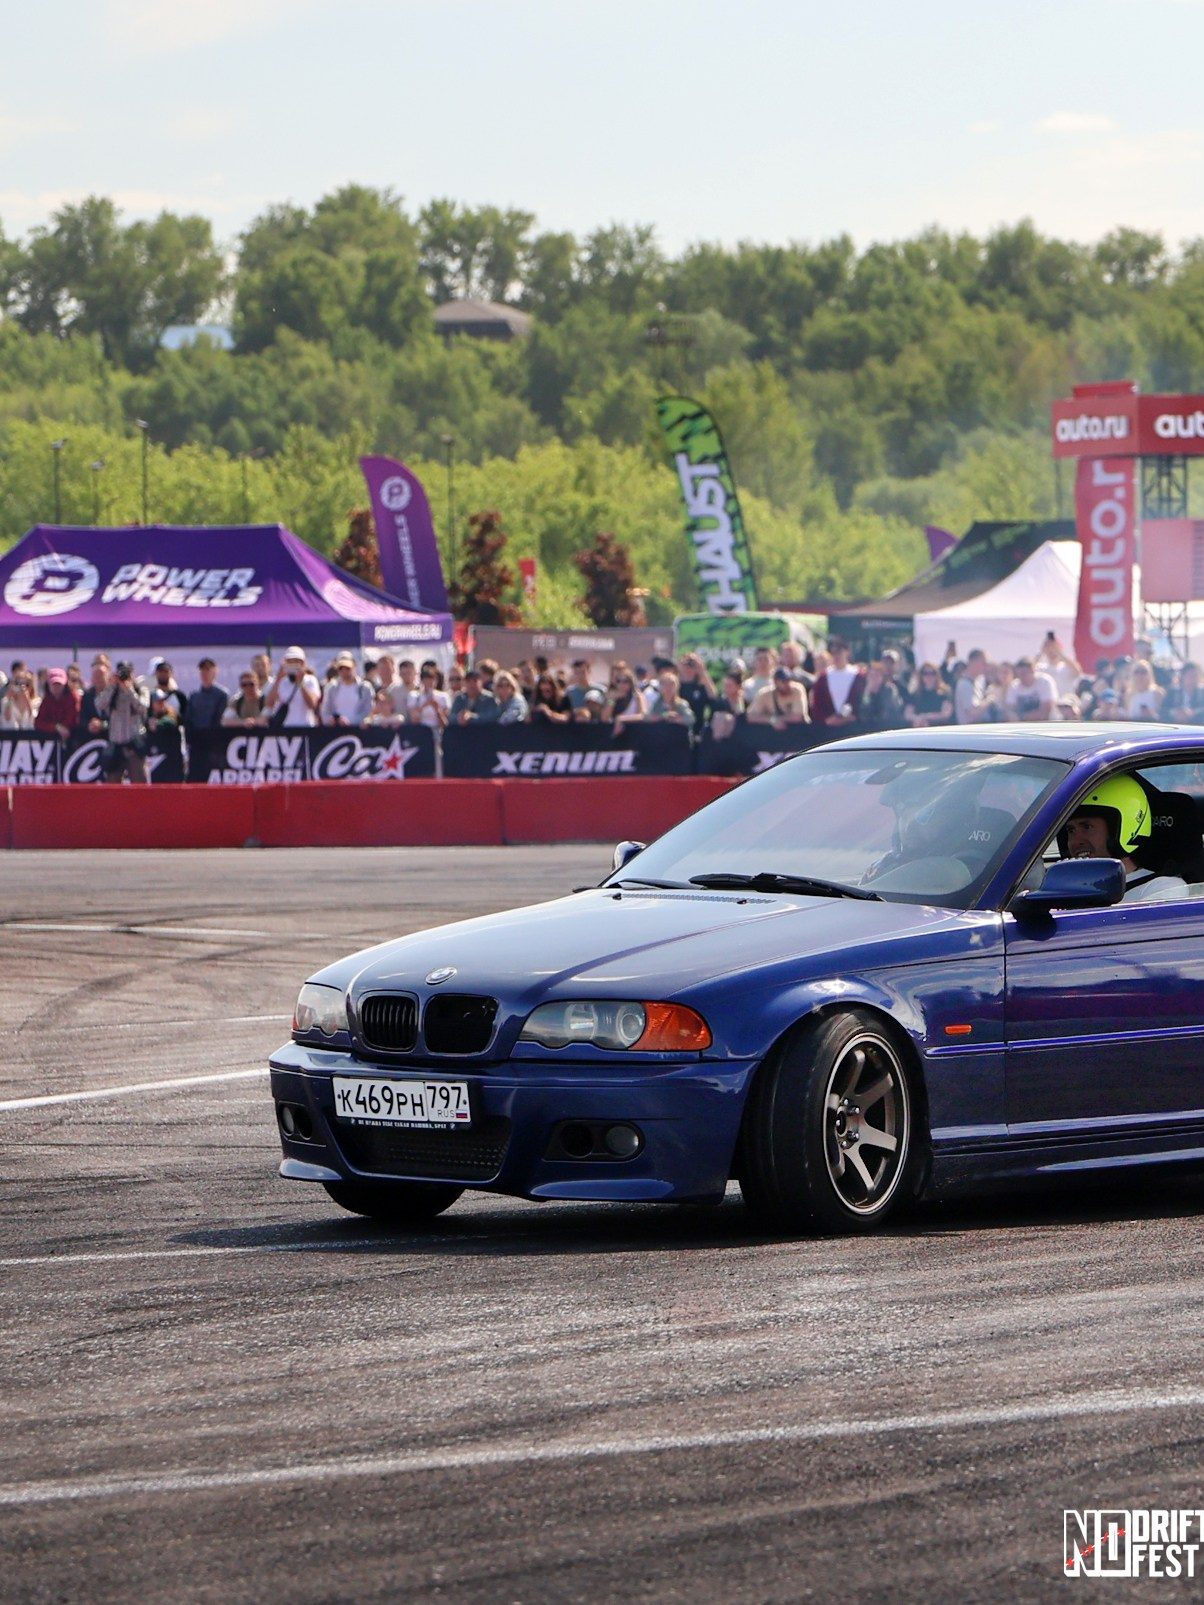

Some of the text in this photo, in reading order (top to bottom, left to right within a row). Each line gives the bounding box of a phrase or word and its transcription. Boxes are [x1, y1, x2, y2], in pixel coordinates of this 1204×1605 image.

[1057, 415, 1129, 443] auto.ru
[110, 563, 255, 590] POWER
[101, 581, 263, 608] WHEELS
[492, 751, 636, 773] XENUM
[426, 1086, 462, 1109] 797
[437, 1109, 456, 1119] RUS
